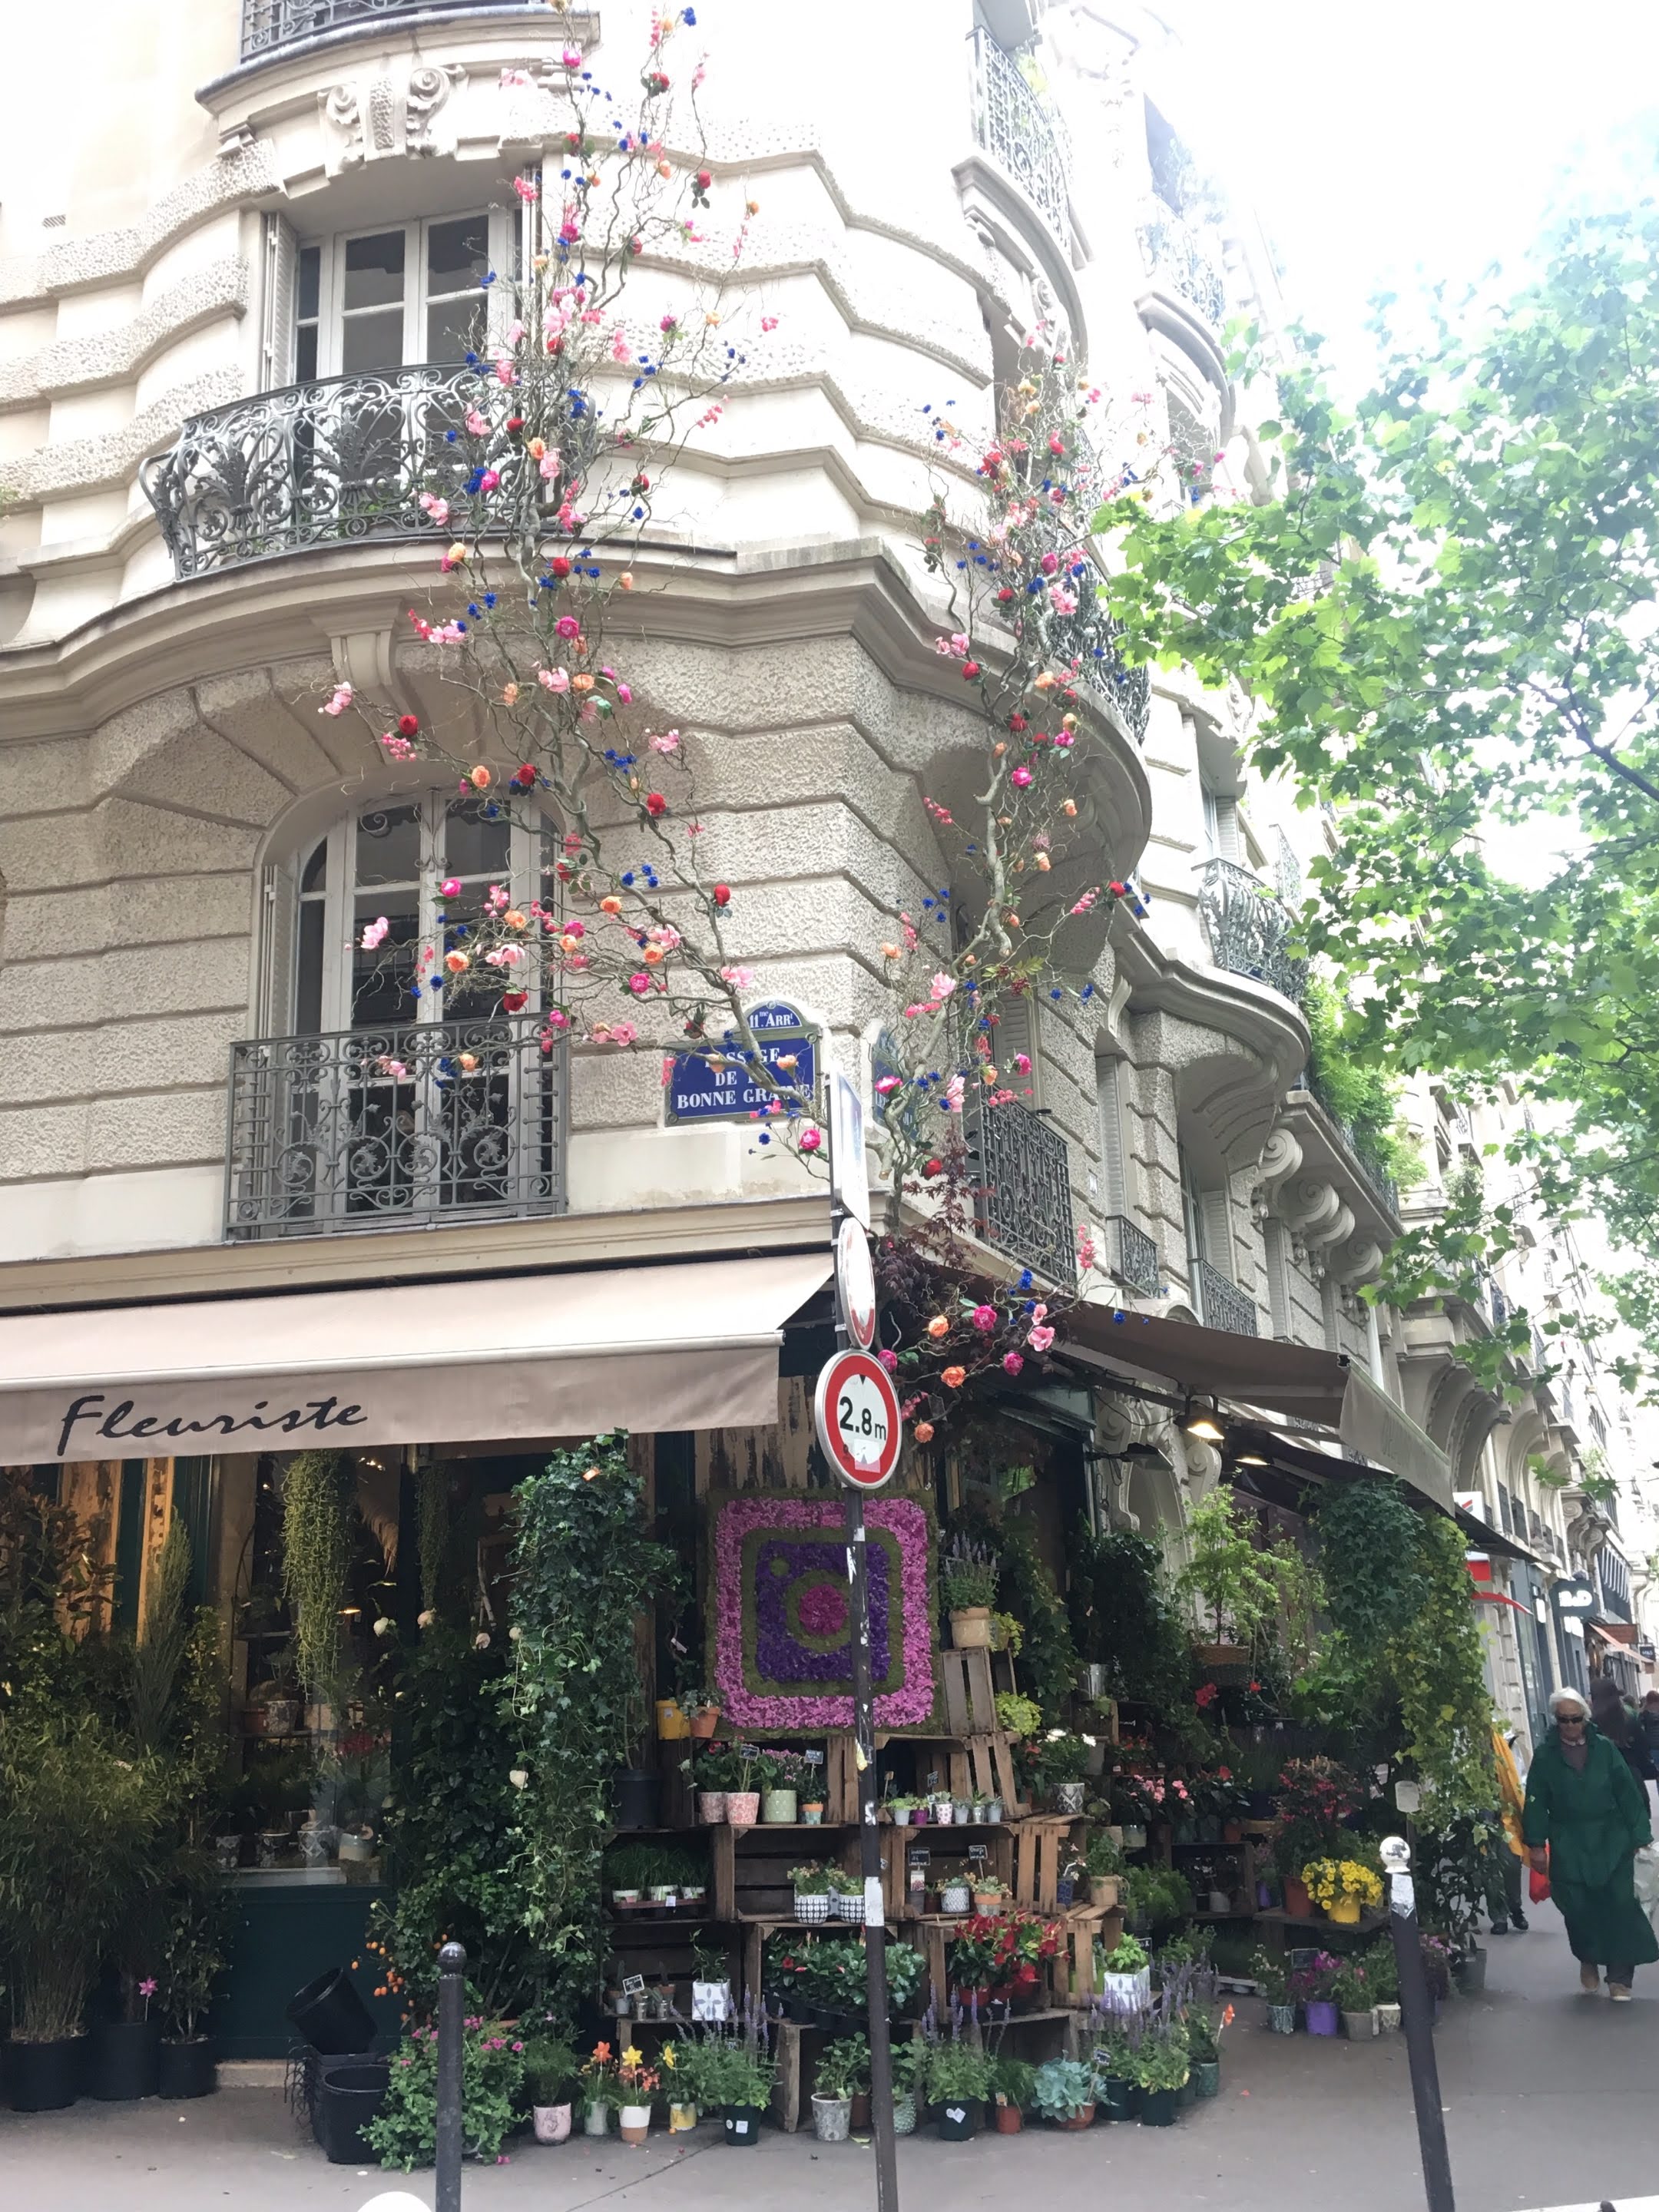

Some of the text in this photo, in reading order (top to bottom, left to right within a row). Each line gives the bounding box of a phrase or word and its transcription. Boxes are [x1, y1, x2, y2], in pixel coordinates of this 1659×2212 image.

[705, 1048, 780, 1068] SSGE
[715, 1071, 737, 1086] DE
[677, 1091, 736, 1109] BONNE
[57, 1394, 368, 1456] Fleuriste
